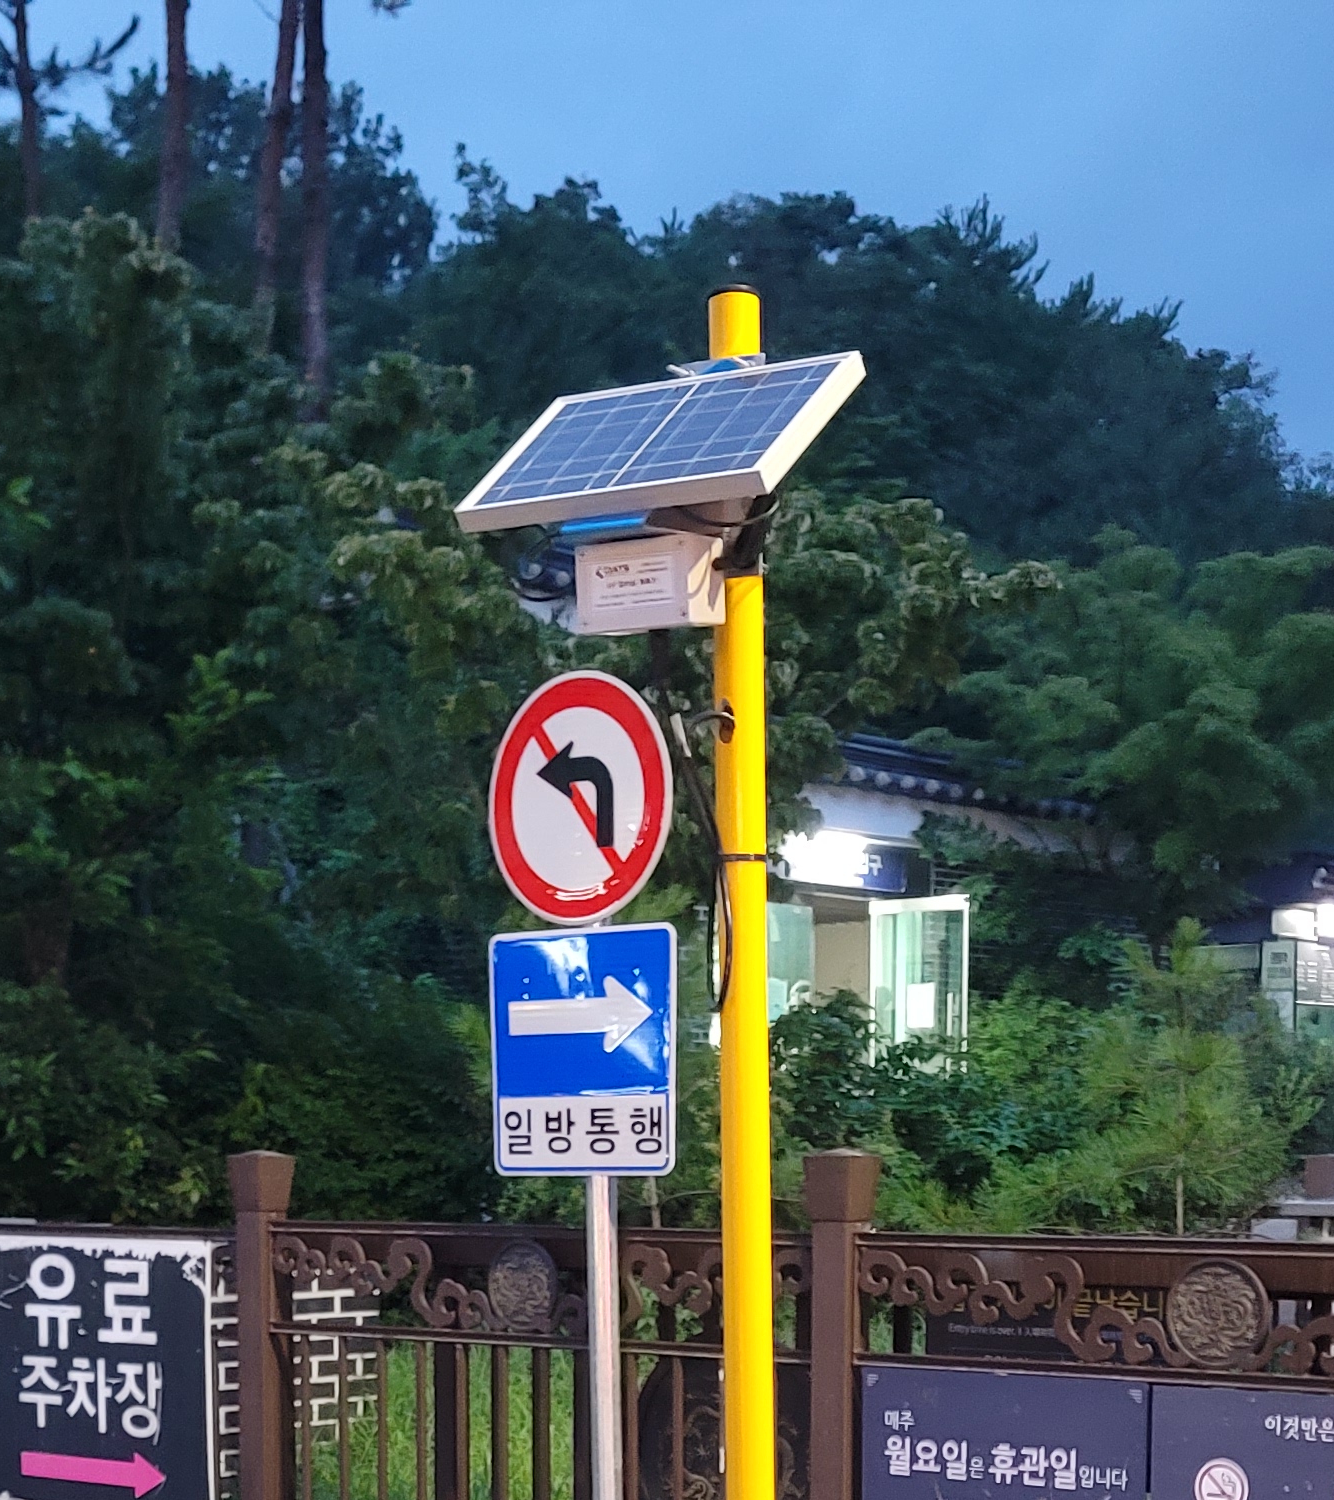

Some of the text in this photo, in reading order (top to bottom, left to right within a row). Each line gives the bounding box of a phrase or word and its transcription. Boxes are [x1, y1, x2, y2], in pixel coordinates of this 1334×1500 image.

[504, 1106, 663, 1155] 일방통행
[24, 1253, 159, 1350] 유료
[18, 1355, 163, 1441] 주차장
[884, 1409, 915, 1431] 매주
[884, 1434, 1129, 1491] 월요일은 휴관일입니다
